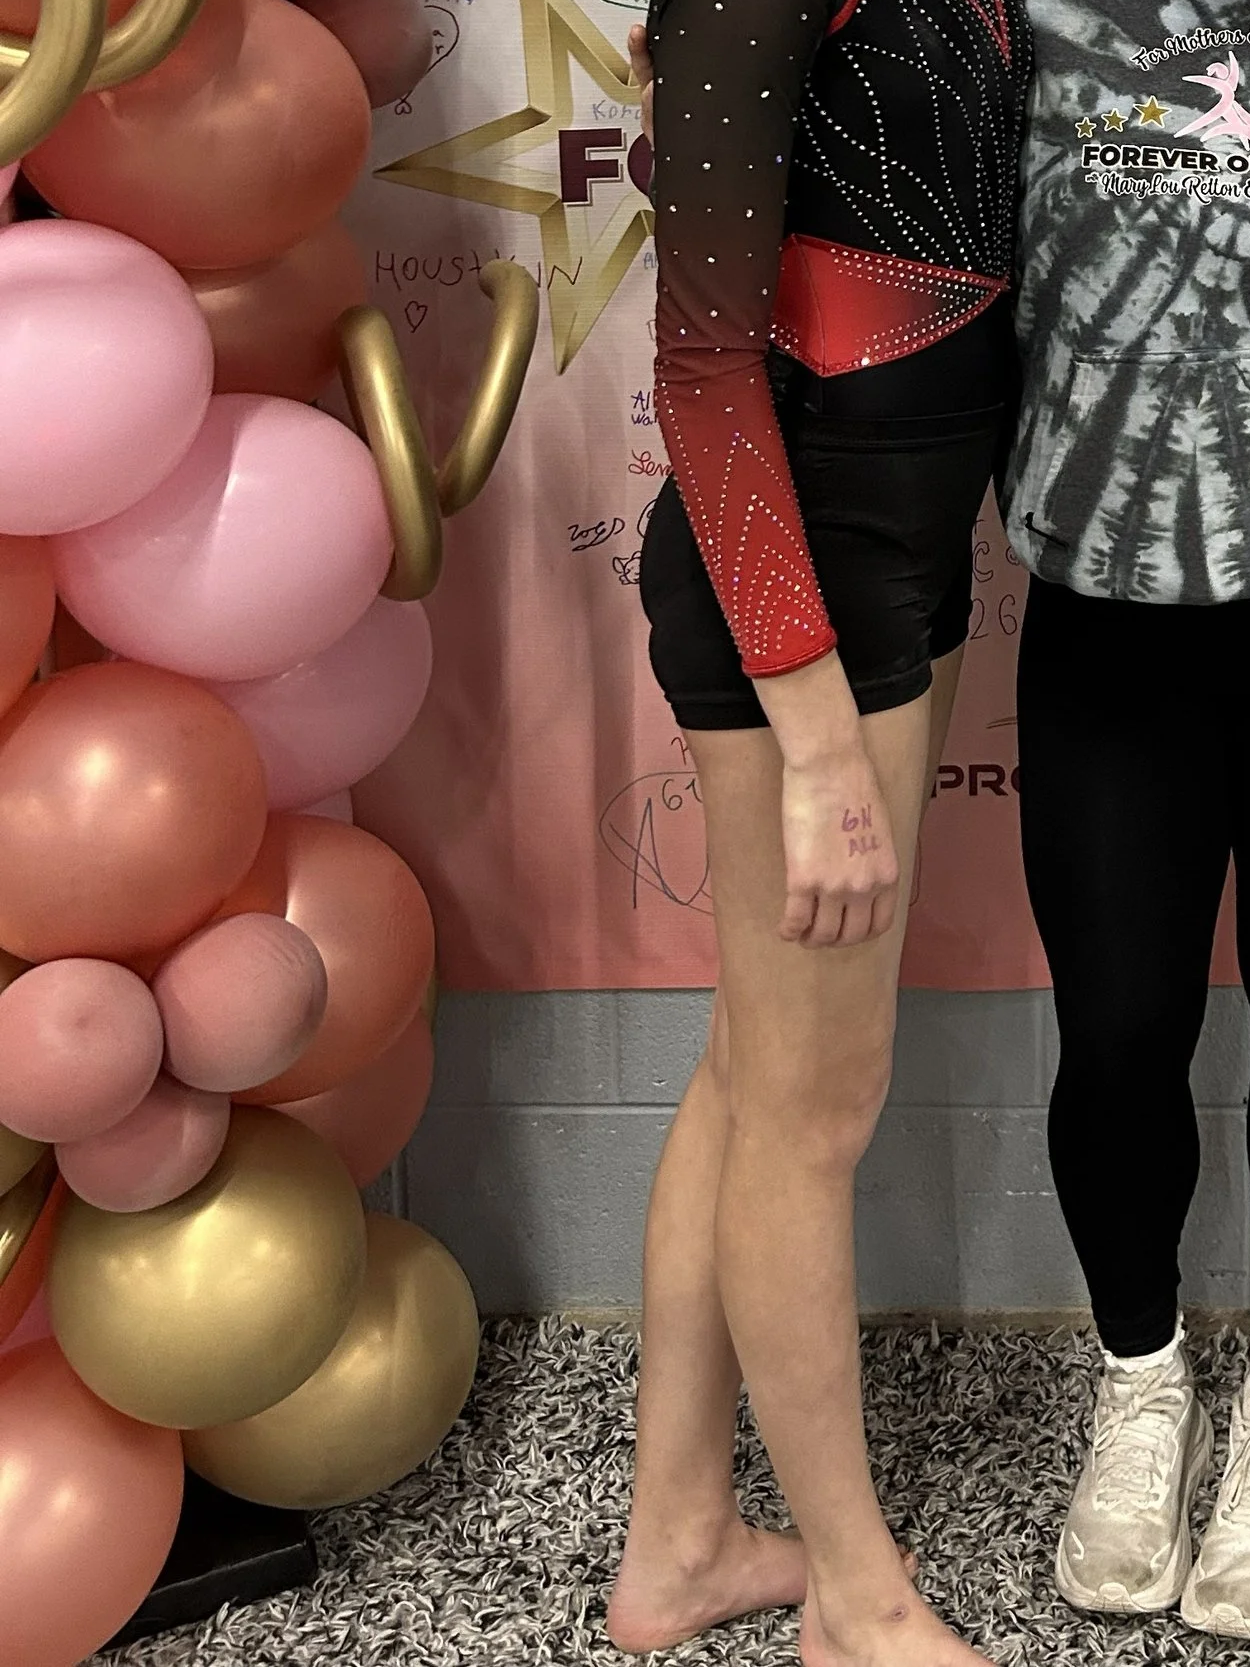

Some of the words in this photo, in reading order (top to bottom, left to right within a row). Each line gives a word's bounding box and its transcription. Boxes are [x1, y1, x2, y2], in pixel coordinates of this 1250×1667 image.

[1130, 45, 1169, 73] For
[1164, 29, 1246, 57] Mothers
[1081, 144, 1220, 172] FOREVER
[1100, 174, 1151, 200] Mary
[1148, 175, 1180, 198] Lou
[1181, 175, 1243, 207] Retton
